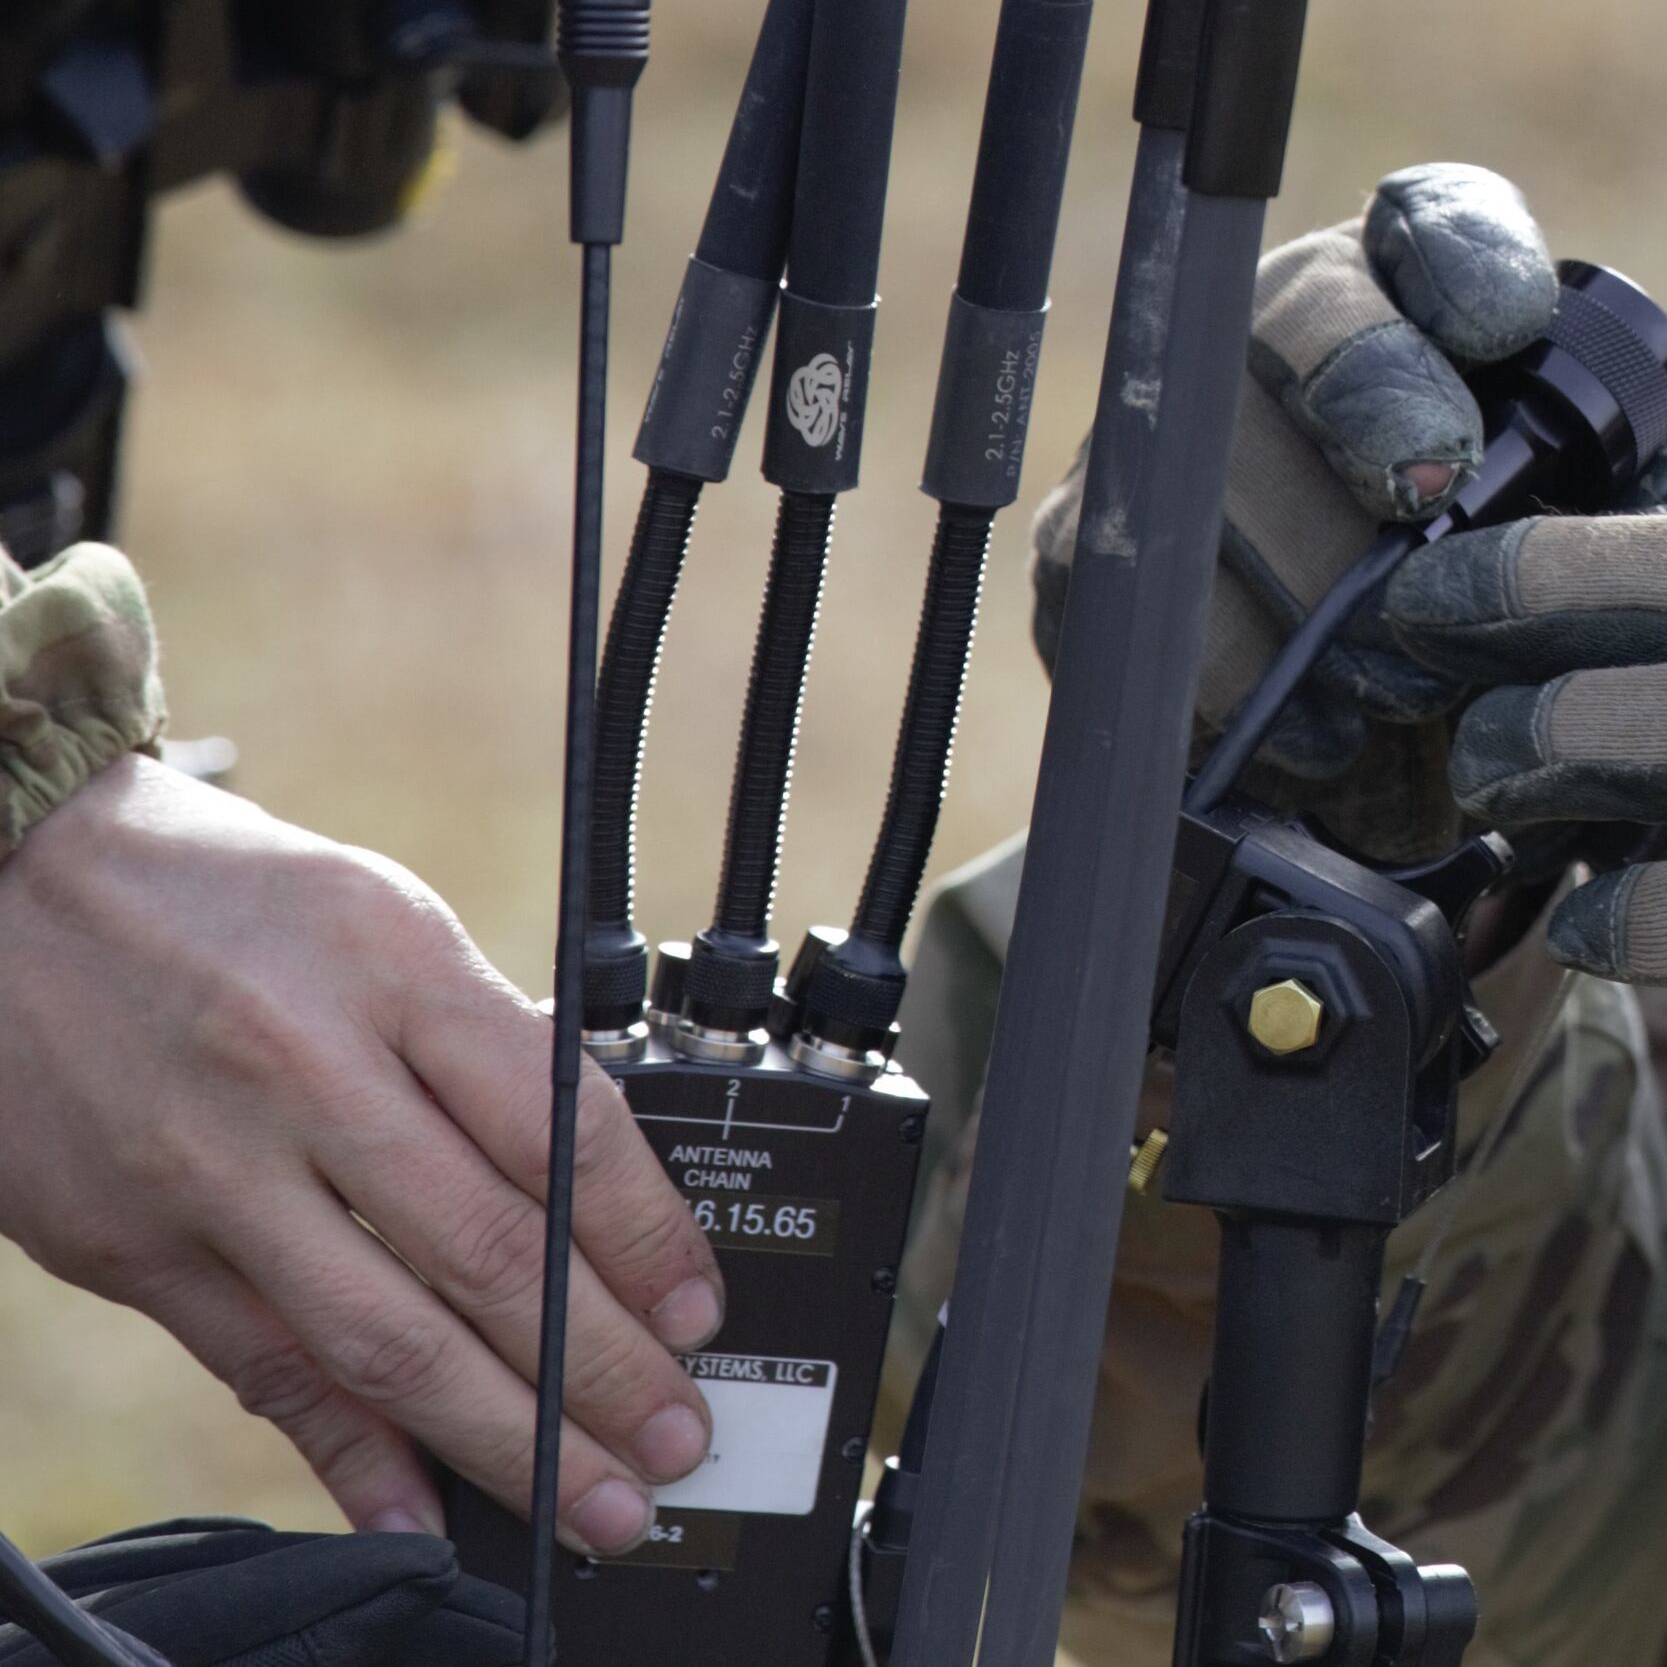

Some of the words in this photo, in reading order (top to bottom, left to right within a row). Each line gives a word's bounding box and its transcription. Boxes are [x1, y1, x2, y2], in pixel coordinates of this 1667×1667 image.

[712, 327, 758, 439] 2.1-2.5GHz
[985, 350, 1020, 461] 2.1-2.5GHz
[726, 1079, 740, 1097] 2
[841, 1095, 851, 1112] 1
[669, 1145, 773, 1168] ANTENNA
[683, 1168, 752, 1190] CHAIN
[686, 1199, 817, 1239] 6.15.65
[675, 1356, 767, 1382] YSTEMS,
[775, 1362, 815, 1383] LLC
